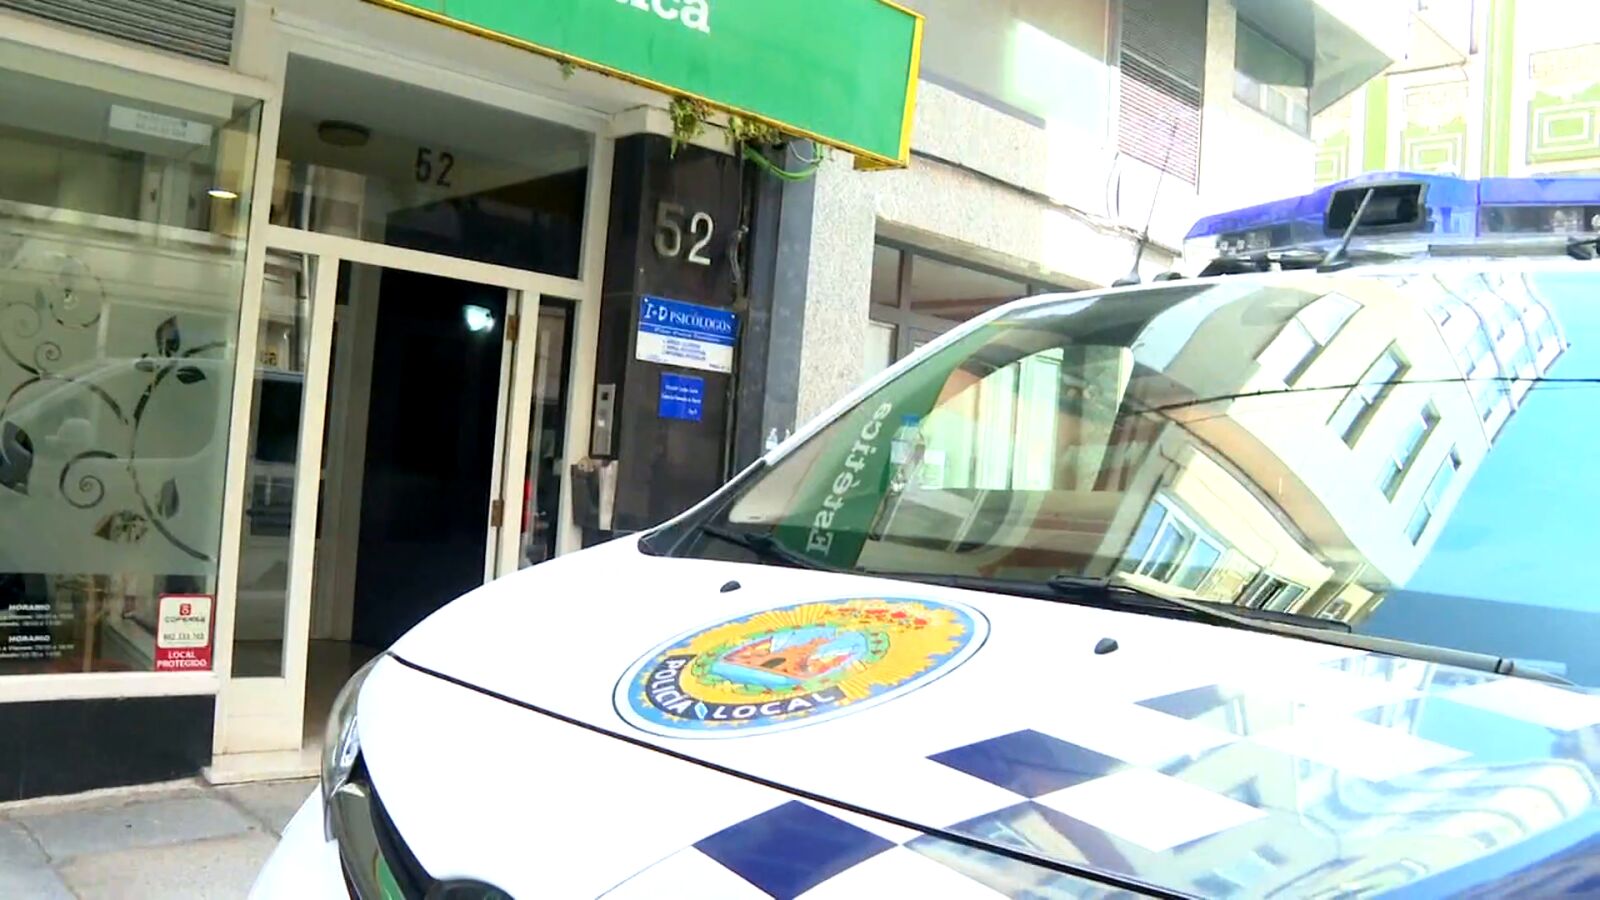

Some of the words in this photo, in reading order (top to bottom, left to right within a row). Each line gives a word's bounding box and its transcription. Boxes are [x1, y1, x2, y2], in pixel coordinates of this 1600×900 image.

[415, 146, 454, 188] 52
[654, 201, 714, 266] 52
[157, 659, 208, 668] PROTEGIDO
[168, 651, 196, 659] LOCAL
[651, 658, 691, 714] POLICÍA
[712, 691, 835, 720] LOCAL
